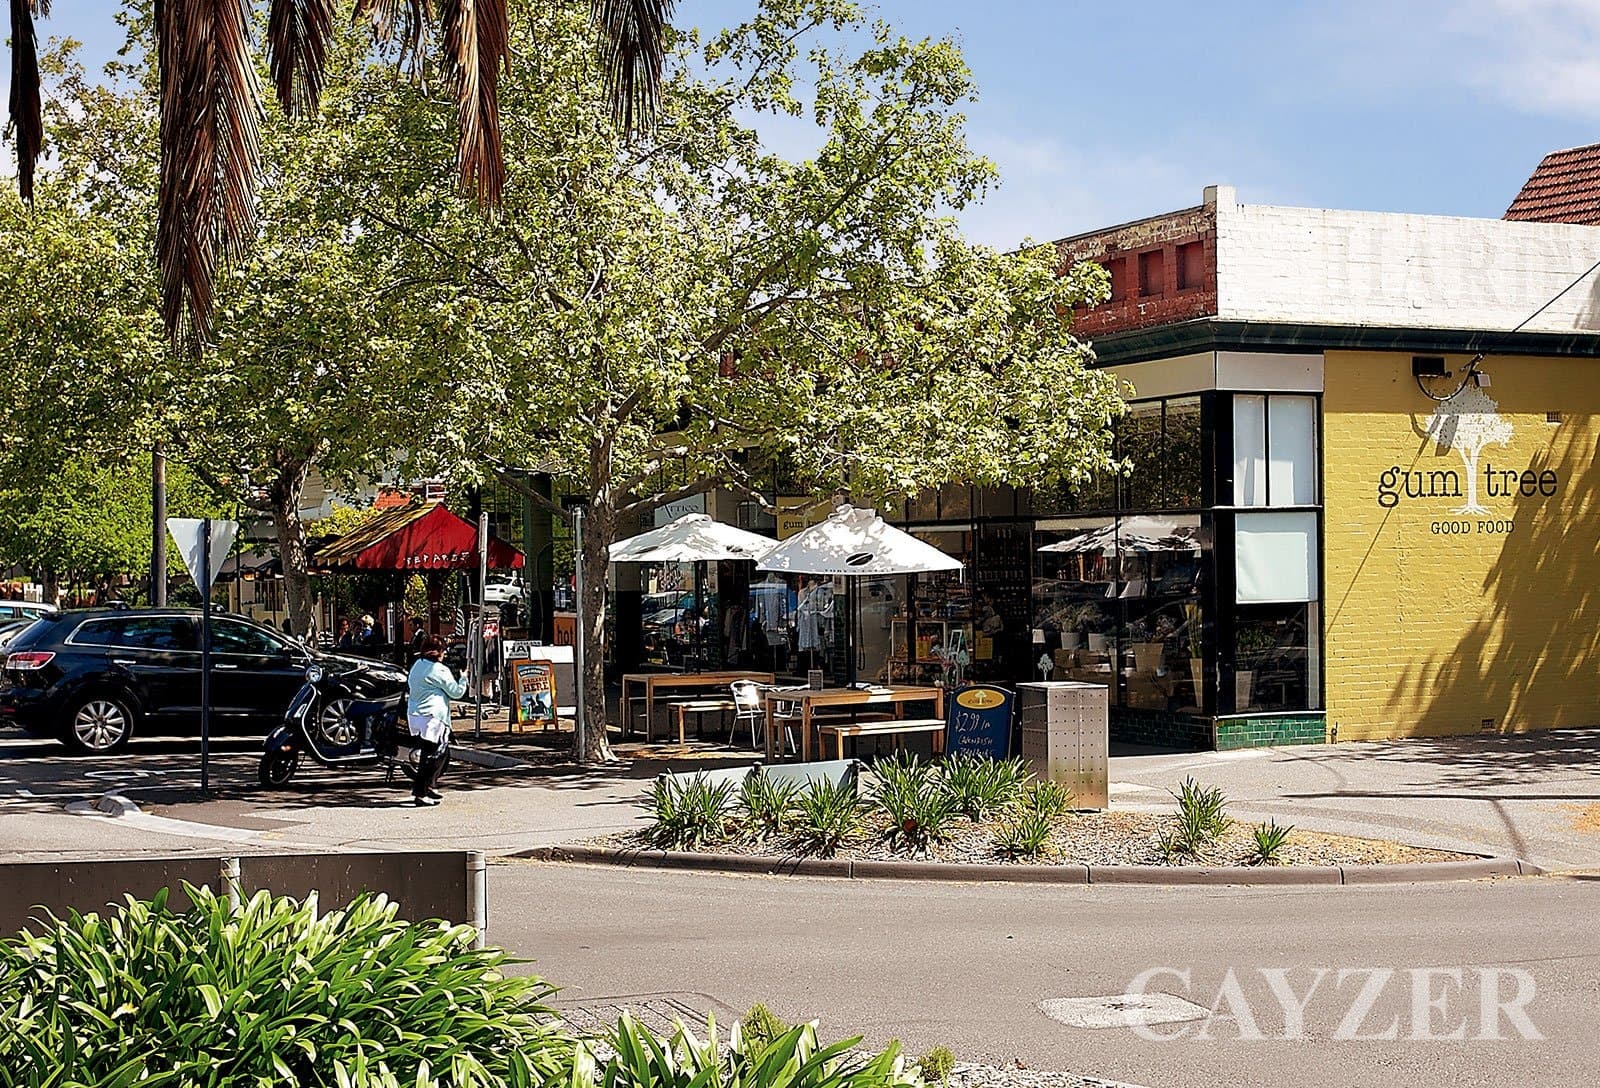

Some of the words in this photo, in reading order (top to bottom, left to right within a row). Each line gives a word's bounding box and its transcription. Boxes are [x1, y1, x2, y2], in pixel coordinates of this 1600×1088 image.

[1378, 466, 1462, 508] gum
[1484, 463, 1557, 497] tree
[783, 520, 803, 531] gum
[1431, 522, 1471, 534] GOOD
[1477, 520, 1515, 534] FOOD
[523, 682, 549, 692] HERE
